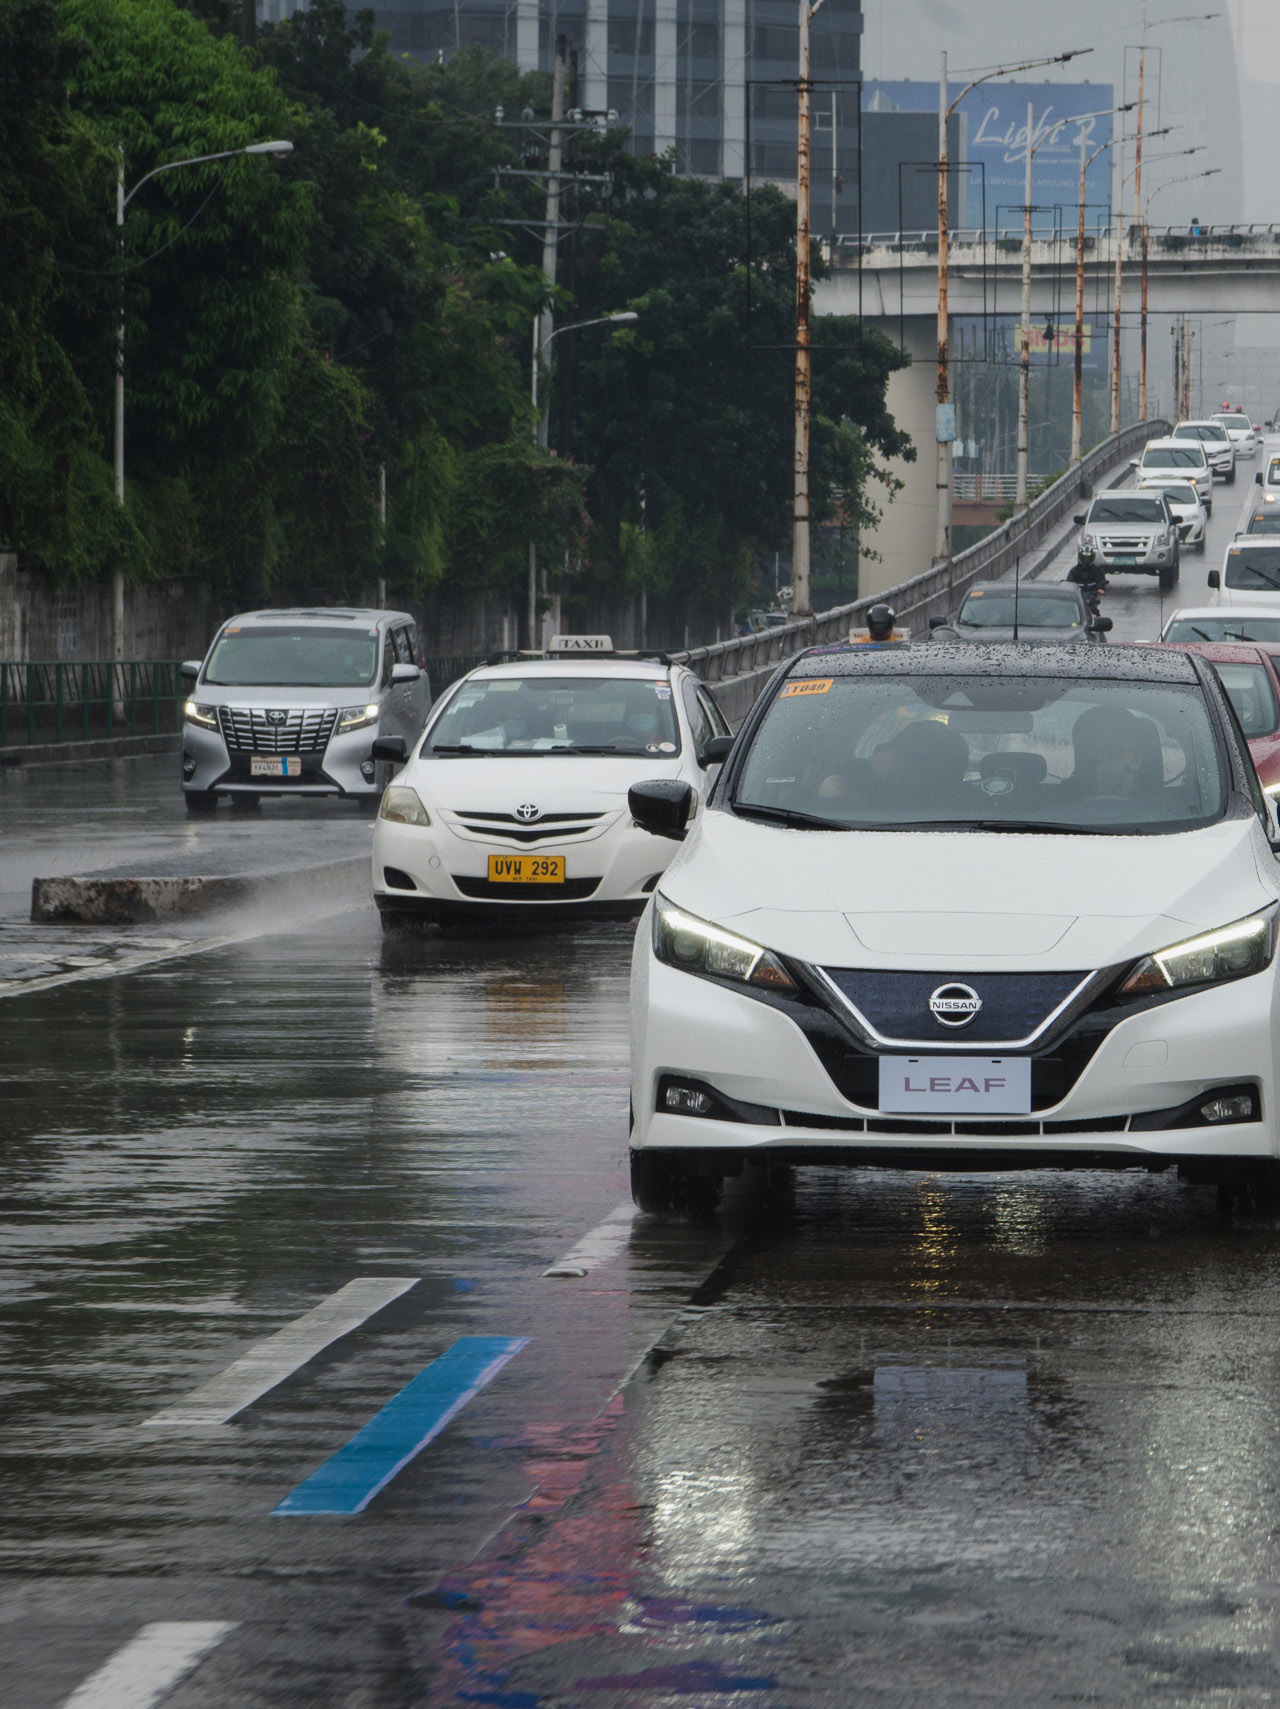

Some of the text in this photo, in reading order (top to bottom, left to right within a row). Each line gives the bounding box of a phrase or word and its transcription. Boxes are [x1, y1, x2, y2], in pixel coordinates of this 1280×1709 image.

[561, 639, 603, 649] TAXI
[495, 860, 558, 876] UVW 292
[932, 1001, 977, 1010] NISSAN
[904, 1076, 1006, 1093] LEAF
